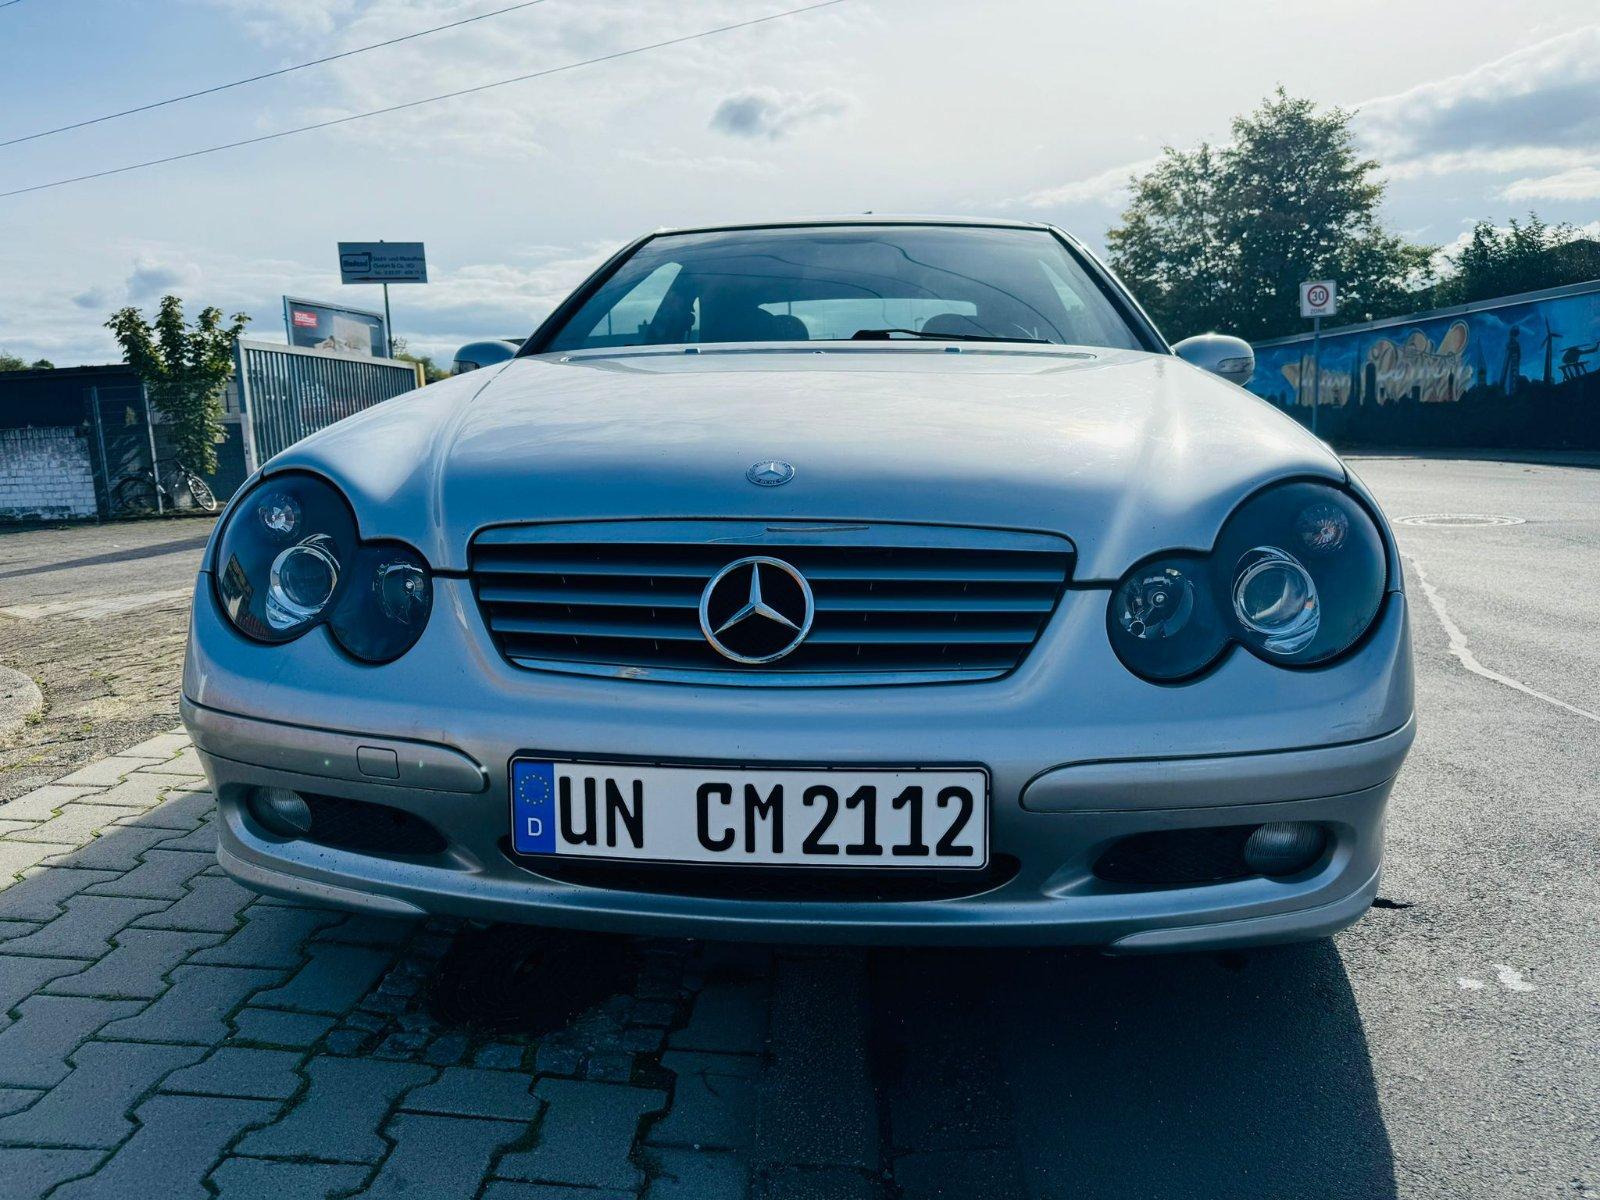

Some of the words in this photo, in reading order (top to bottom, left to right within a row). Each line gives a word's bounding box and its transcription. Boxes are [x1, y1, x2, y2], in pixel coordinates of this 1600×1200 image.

[1312, 290, 1325, 301] 30
[559, 776, 644, 849] UN
[696, 782, 784, 852] CM
[802, 785, 974, 857] 2112
[527, 817, 543, 837] D
